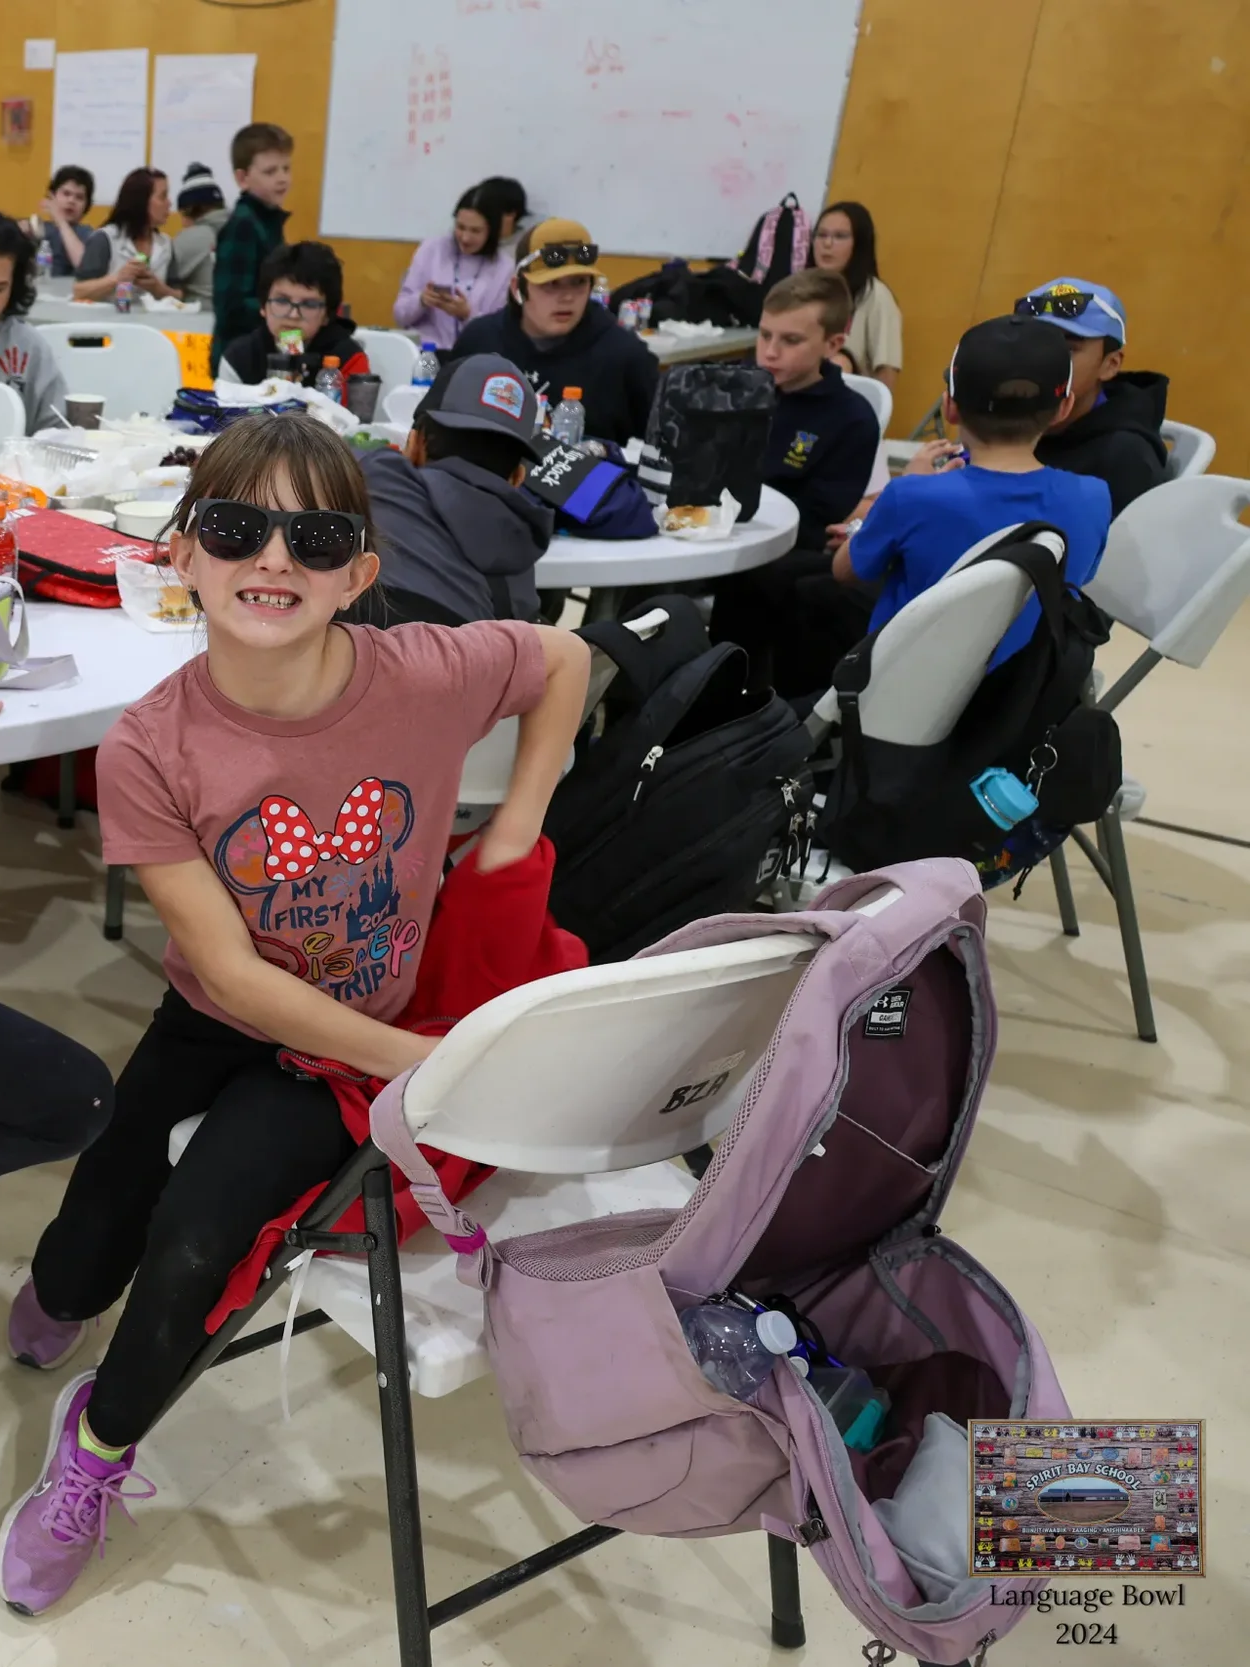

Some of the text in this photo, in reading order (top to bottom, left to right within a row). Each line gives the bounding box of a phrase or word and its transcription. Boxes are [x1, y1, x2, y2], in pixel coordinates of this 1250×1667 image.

[291, 875, 328, 901] MY
[274, 902, 344, 931] FIRST
[329, 961, 386, 1001] TRIP
[659, 1071, 730, 1114] BZA
